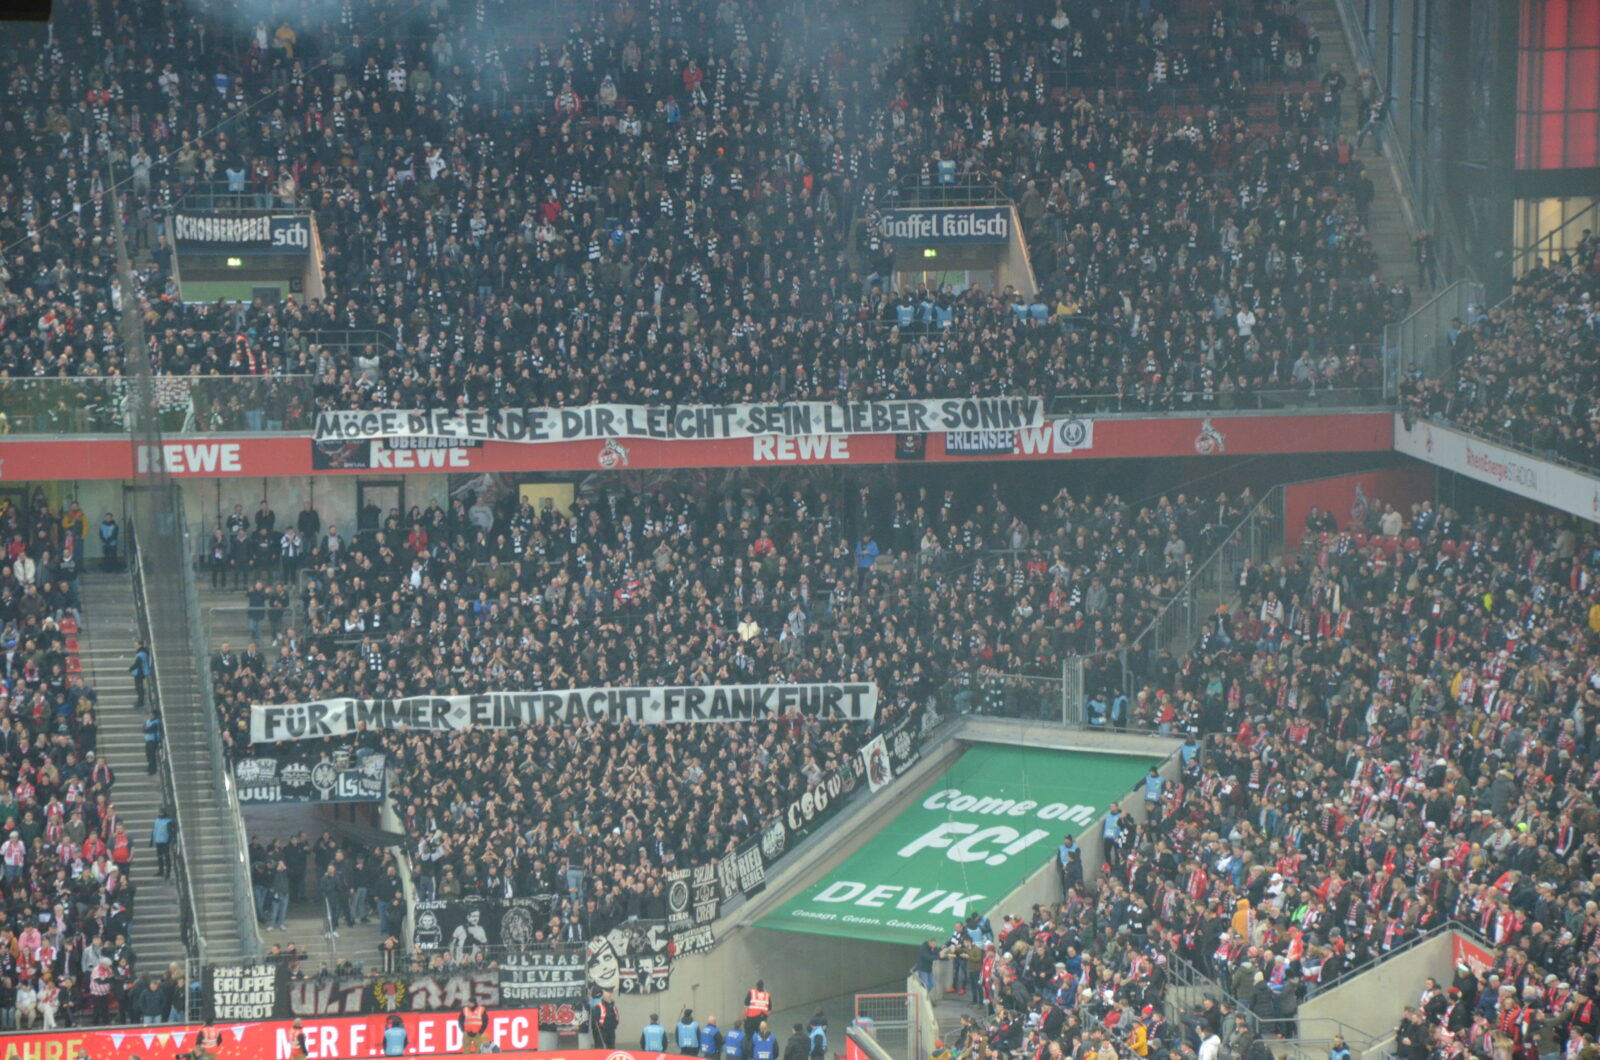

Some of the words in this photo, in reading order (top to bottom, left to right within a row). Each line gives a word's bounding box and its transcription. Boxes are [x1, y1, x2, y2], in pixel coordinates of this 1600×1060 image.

[880, 213, 940, 239] Gaffel
[942, 211, 1008, 239] Kölsch
[407, 411, 457, 436] DIE
[465, 411, 550, 441] ERDE
[560, 408, 620, 439] DIR
[625, 407, 738, 438] LEICHT
[746, 405, 813, 436] SEIN
[823, 402, 931, 433] LIEBER
[941, 398, 1038, 430] SONNY
[137, 443, 242, 473] REWE
[753, 434, 850, 461] REWE
[263, 703, 333, 739] FÜR
[344, 698, 457, 730] IMMER
[469, 688, 650, 729] EINTRACHT
[663, 684, 870, 721] FRANKFURT
[922, 788, 1038, 816] Come
[1036, 801, 1096, 827] on,
[896, 821, 1050, 866] FC!
[812, 880, 988, 918] DEVK
[506, 954, 580, 966] ULTRAS
[213, 976, 276, 993] GRUPPE
[512, 970, 574, 983] NEVER
[214, 990, 276, 1006] STADION
[502, 986, 583, 1000] SURRENDER
[214, 1003, 275, 1019] VERBOT
[492, 1016, 529, 1049] FC
